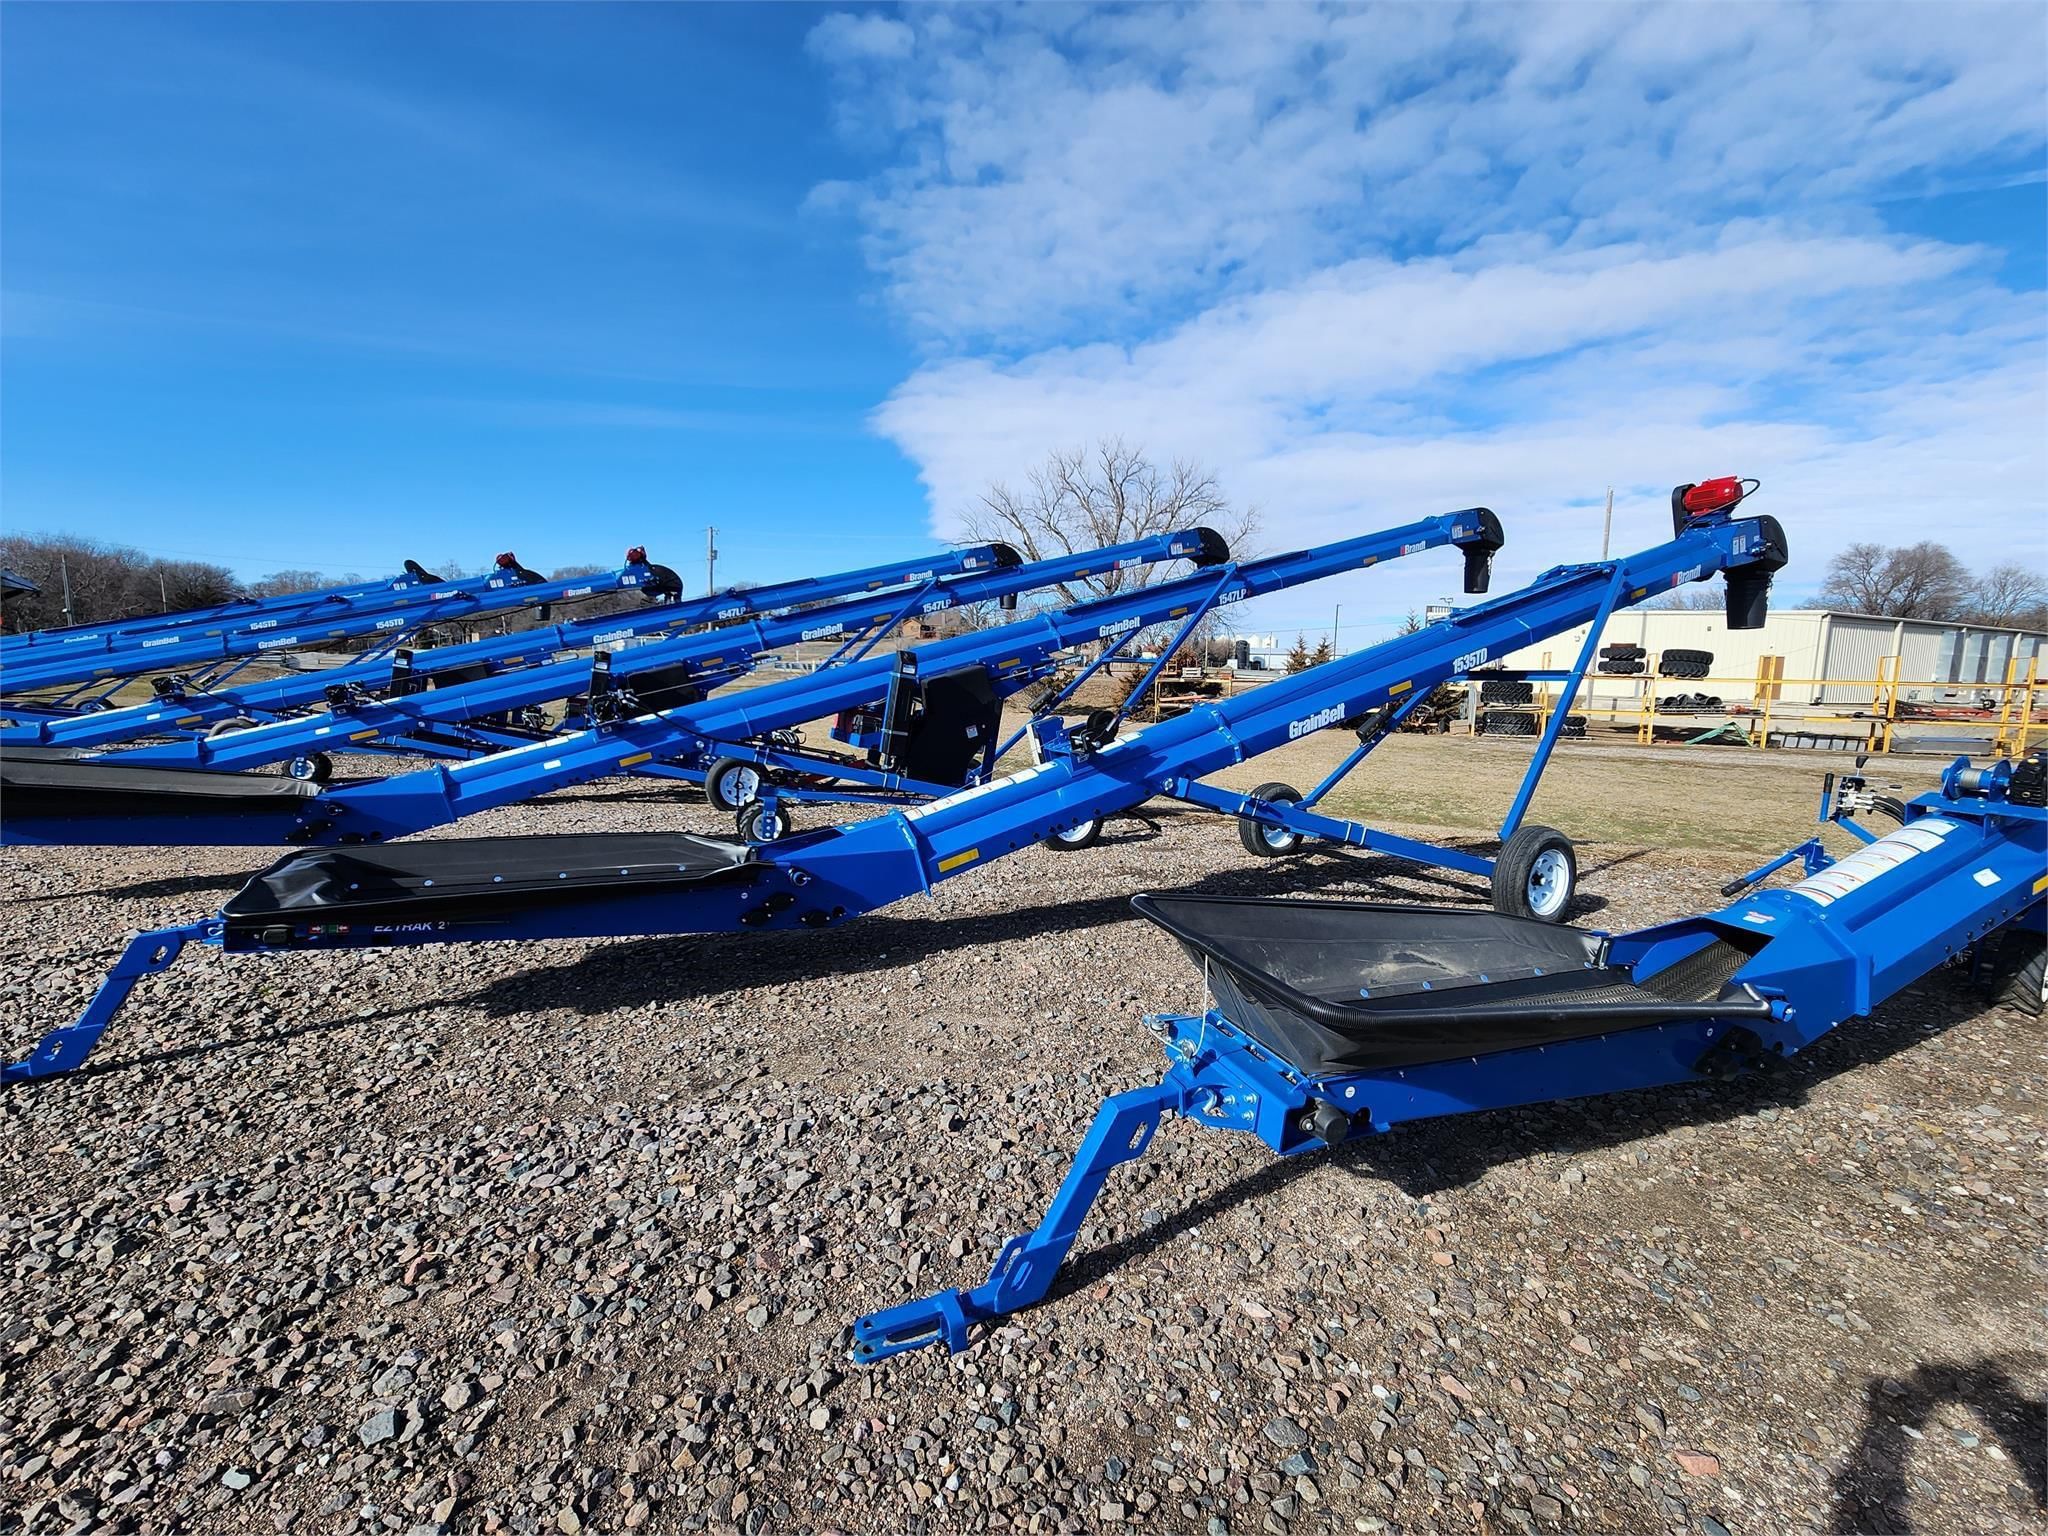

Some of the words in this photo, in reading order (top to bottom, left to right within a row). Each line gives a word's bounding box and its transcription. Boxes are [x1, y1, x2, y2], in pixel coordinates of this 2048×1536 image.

[1405, 540, 1426, 553] Brandt
[1119, 556, 1142, 569] Brandt
[910, 570, 933, 582] Brandt
[1677, 564, 1702, 586] Brandt
[568, 587, 592, 597] Brandt
[376, 618, 404, 630] 1545TD
[1100, 616, 1141, 638] GrainBelt
[593, 628, 634, 645] GrainBelt
[802, 622, 844, 641] GrainBelt
[143, 636, 180, 648] GrainBelt
[258, 636, 298, 649] GrainBelt
[1452, 648, 1488, 674] 1535TD
[1289, 703, 1345, 739] GrainBelt
